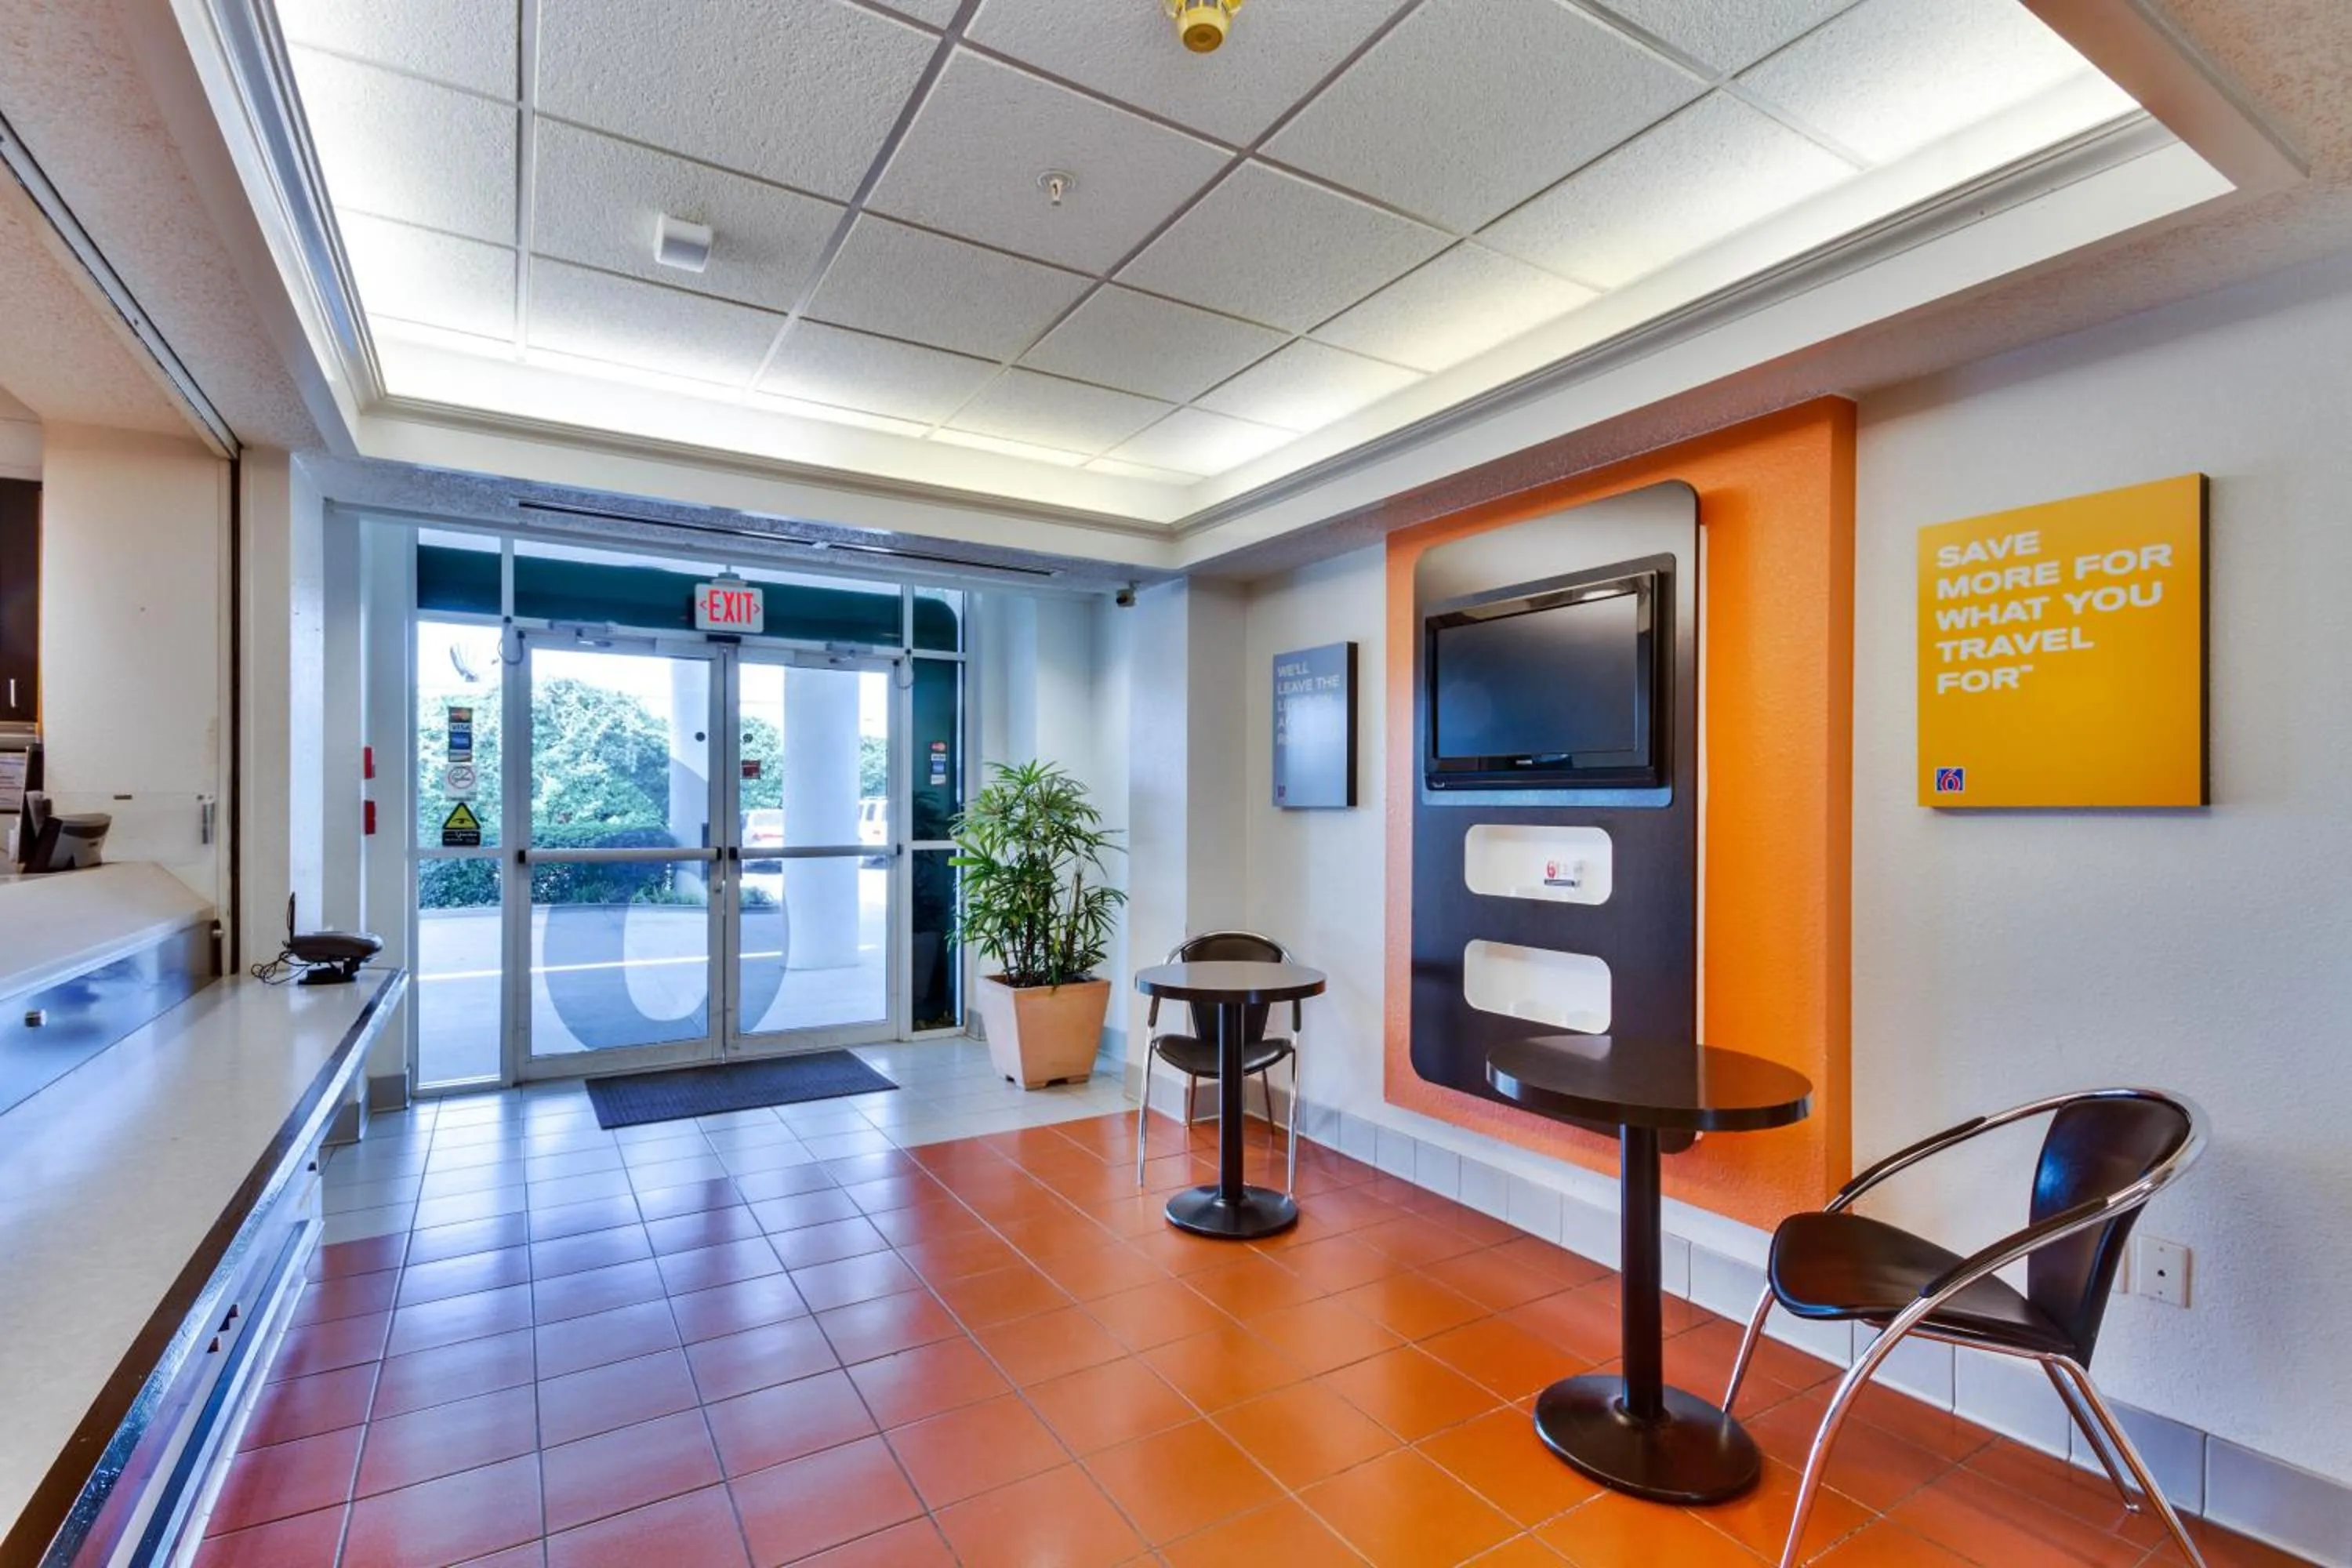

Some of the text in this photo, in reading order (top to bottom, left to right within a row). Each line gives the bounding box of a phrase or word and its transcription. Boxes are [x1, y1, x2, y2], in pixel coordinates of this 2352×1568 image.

[1936, 531, 2041, 568] SAVE
[1936, 543, 2172, 601] MORE FOR
[709, 589, 754, 625] EXIT
[1936, 581, 2163, 630] WHAT YOU
[1936, 626, 2095, 662] TRAVEL
[1277, 674, 1341, 695] LEAVE THE
